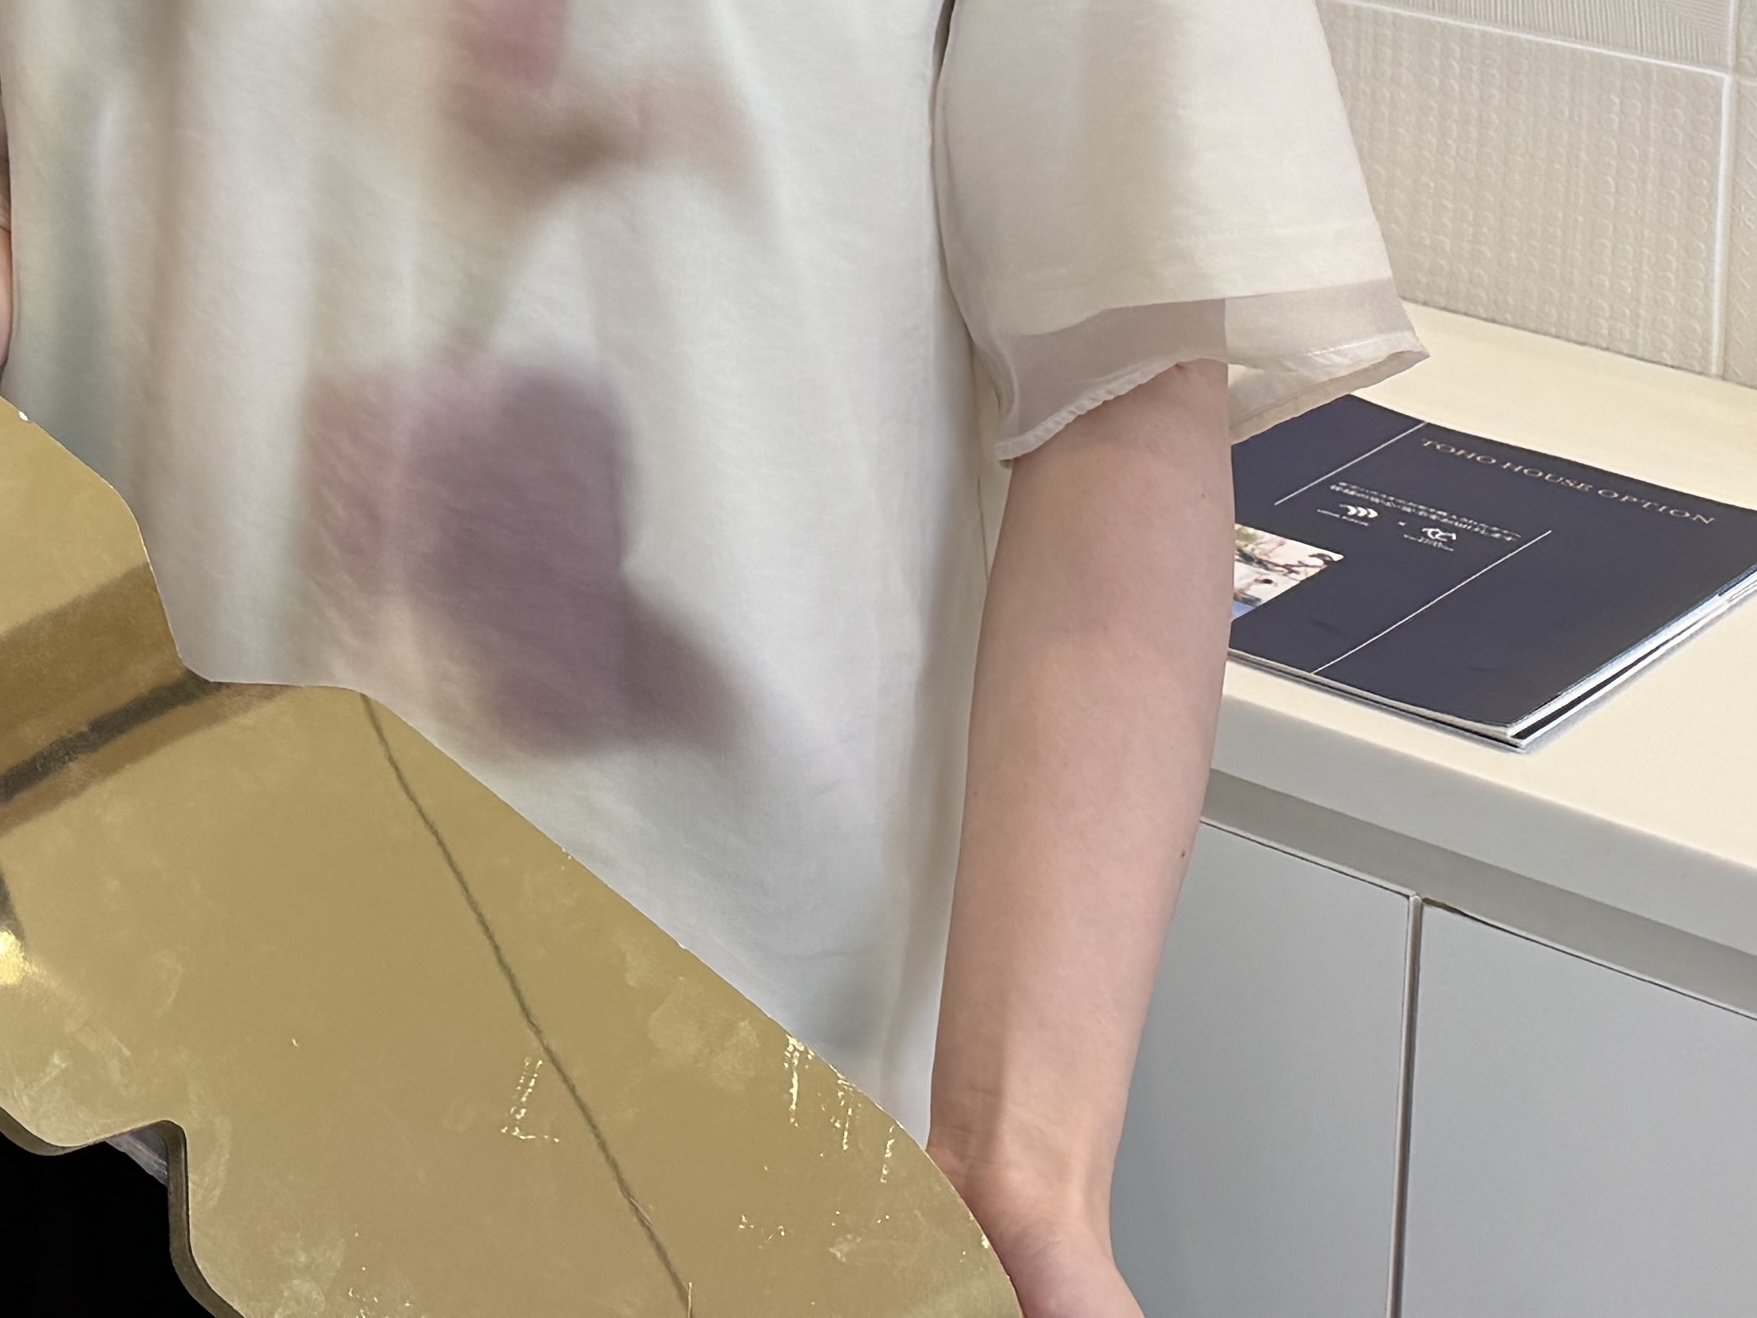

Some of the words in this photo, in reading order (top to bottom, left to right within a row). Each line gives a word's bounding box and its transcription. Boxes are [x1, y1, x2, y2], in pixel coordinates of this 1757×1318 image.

[1422, 437, 1497, 465] TOHO
[1502, 461, 1593, 492] HOUSE
[1597, 488, 1716, 525] OPTION
